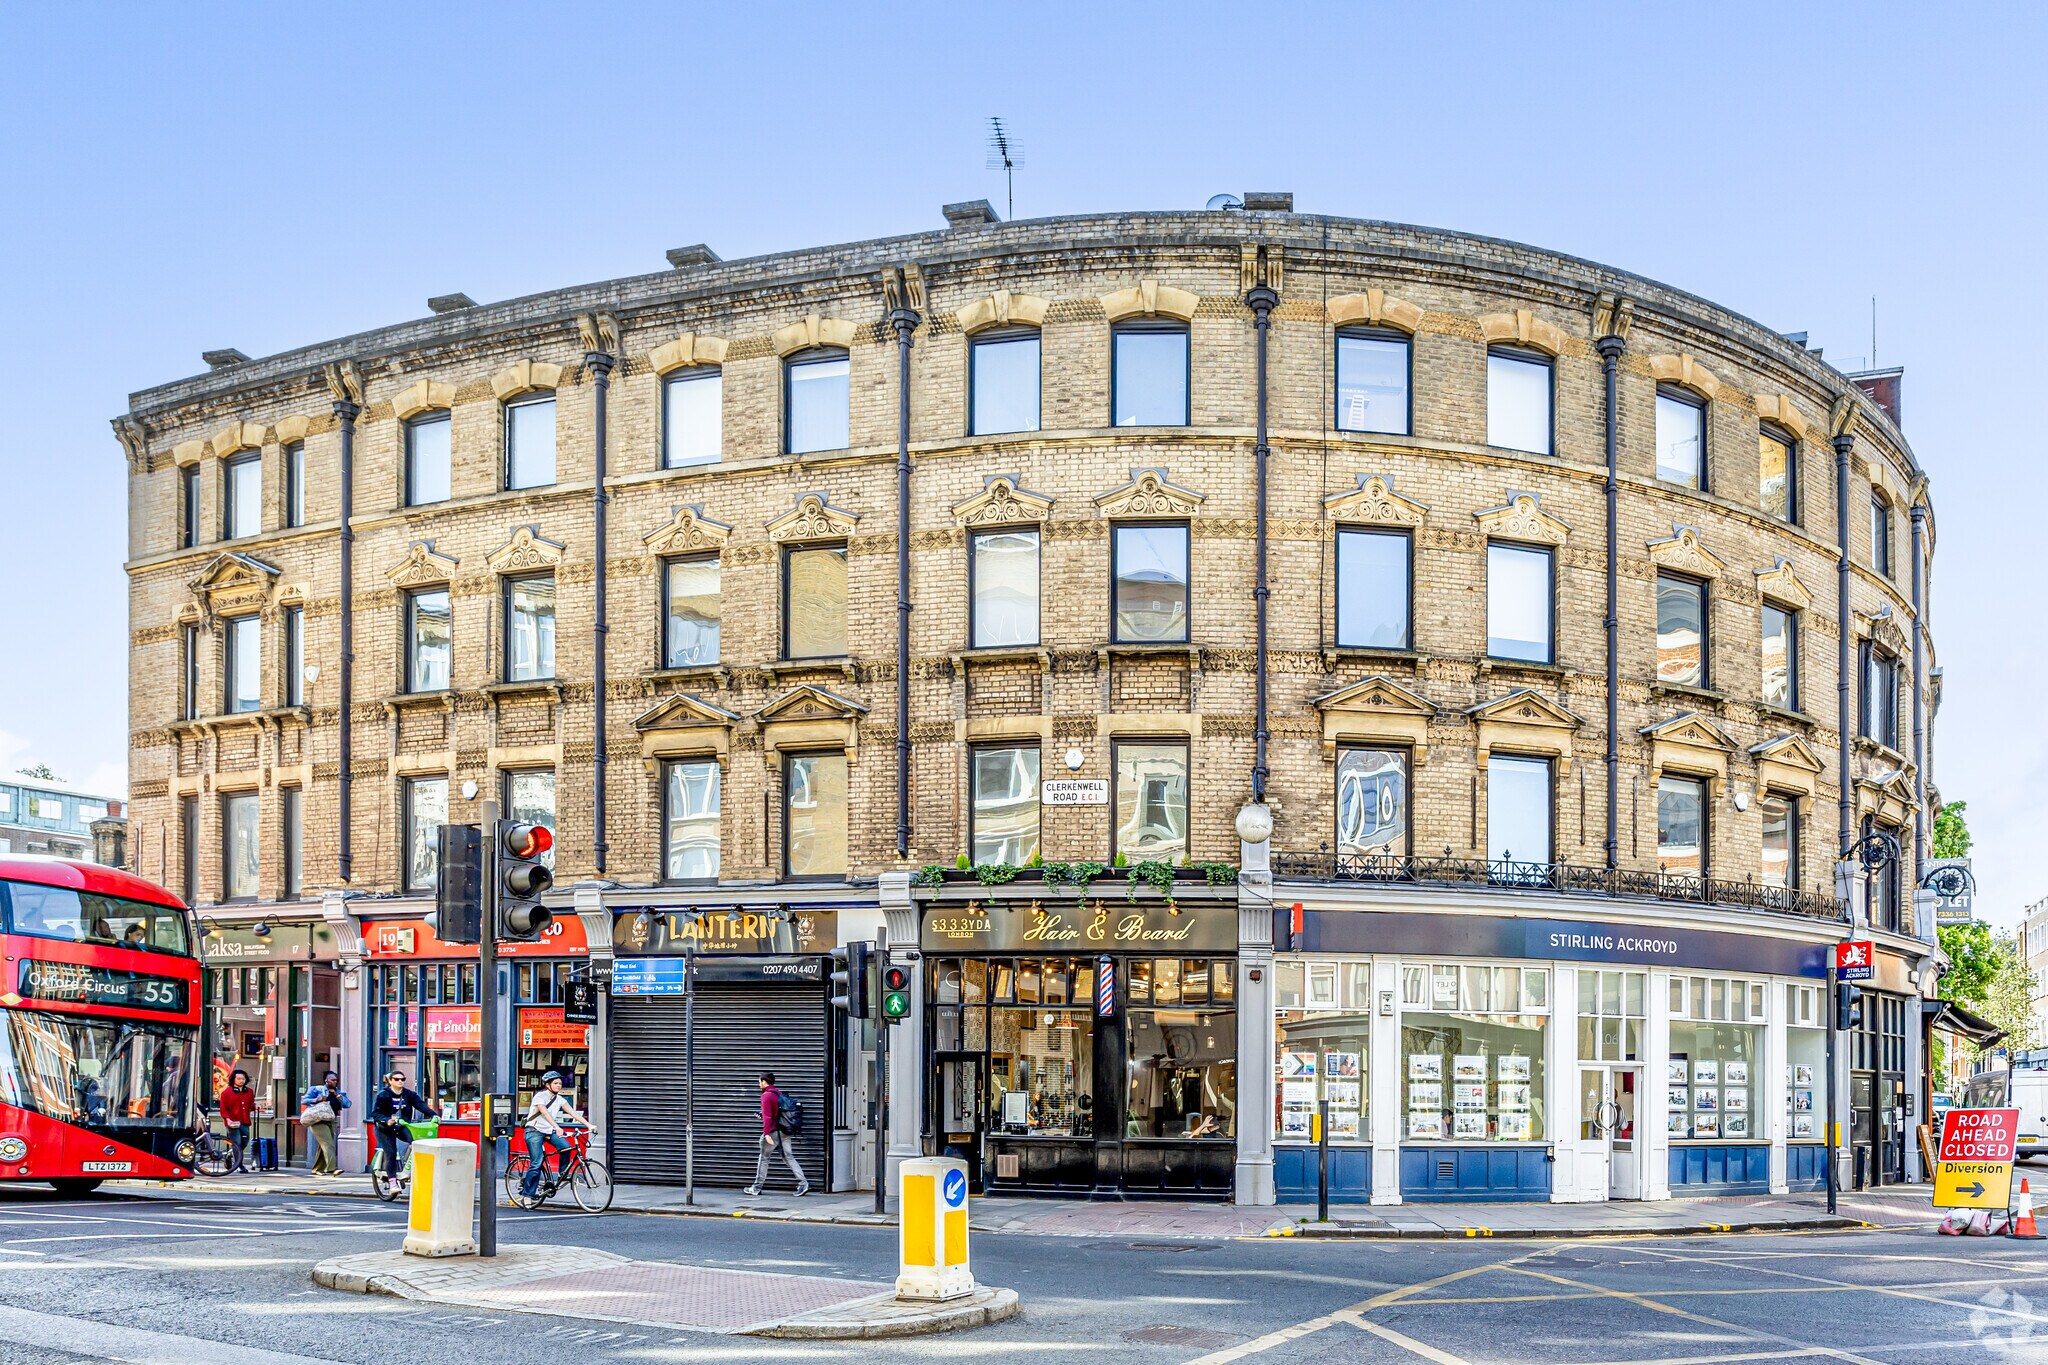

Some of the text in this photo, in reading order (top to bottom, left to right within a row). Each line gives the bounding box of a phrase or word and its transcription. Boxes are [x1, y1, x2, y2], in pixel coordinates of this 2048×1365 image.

[1046, 783, 1104, 792] CLERKENWELL
[1053, 793, 1078, 801] ROAD
[1947, 895, 1969, 908] LET
[669, 914, 776, 940] LANTERN
[1023, 914, 1196, 941] Hair & Beard
[382, 933, 396, 946] 19
[1550, 933, 1677, 954] STIRLING ACKROYD
[762, 965, 818, 974] 0207 490 4407
[28, 972, 126, 995] Oxford Circus
[144, 981, 175, 1004] 55
[1958, 1114, 2003, 1127] ROAD
[1950, 1129, 2007, 1142] AHEAD
[1945, 1144, 2009, 1157] CLOSED
[1945, 1163, 2003, 1174] Diversion
